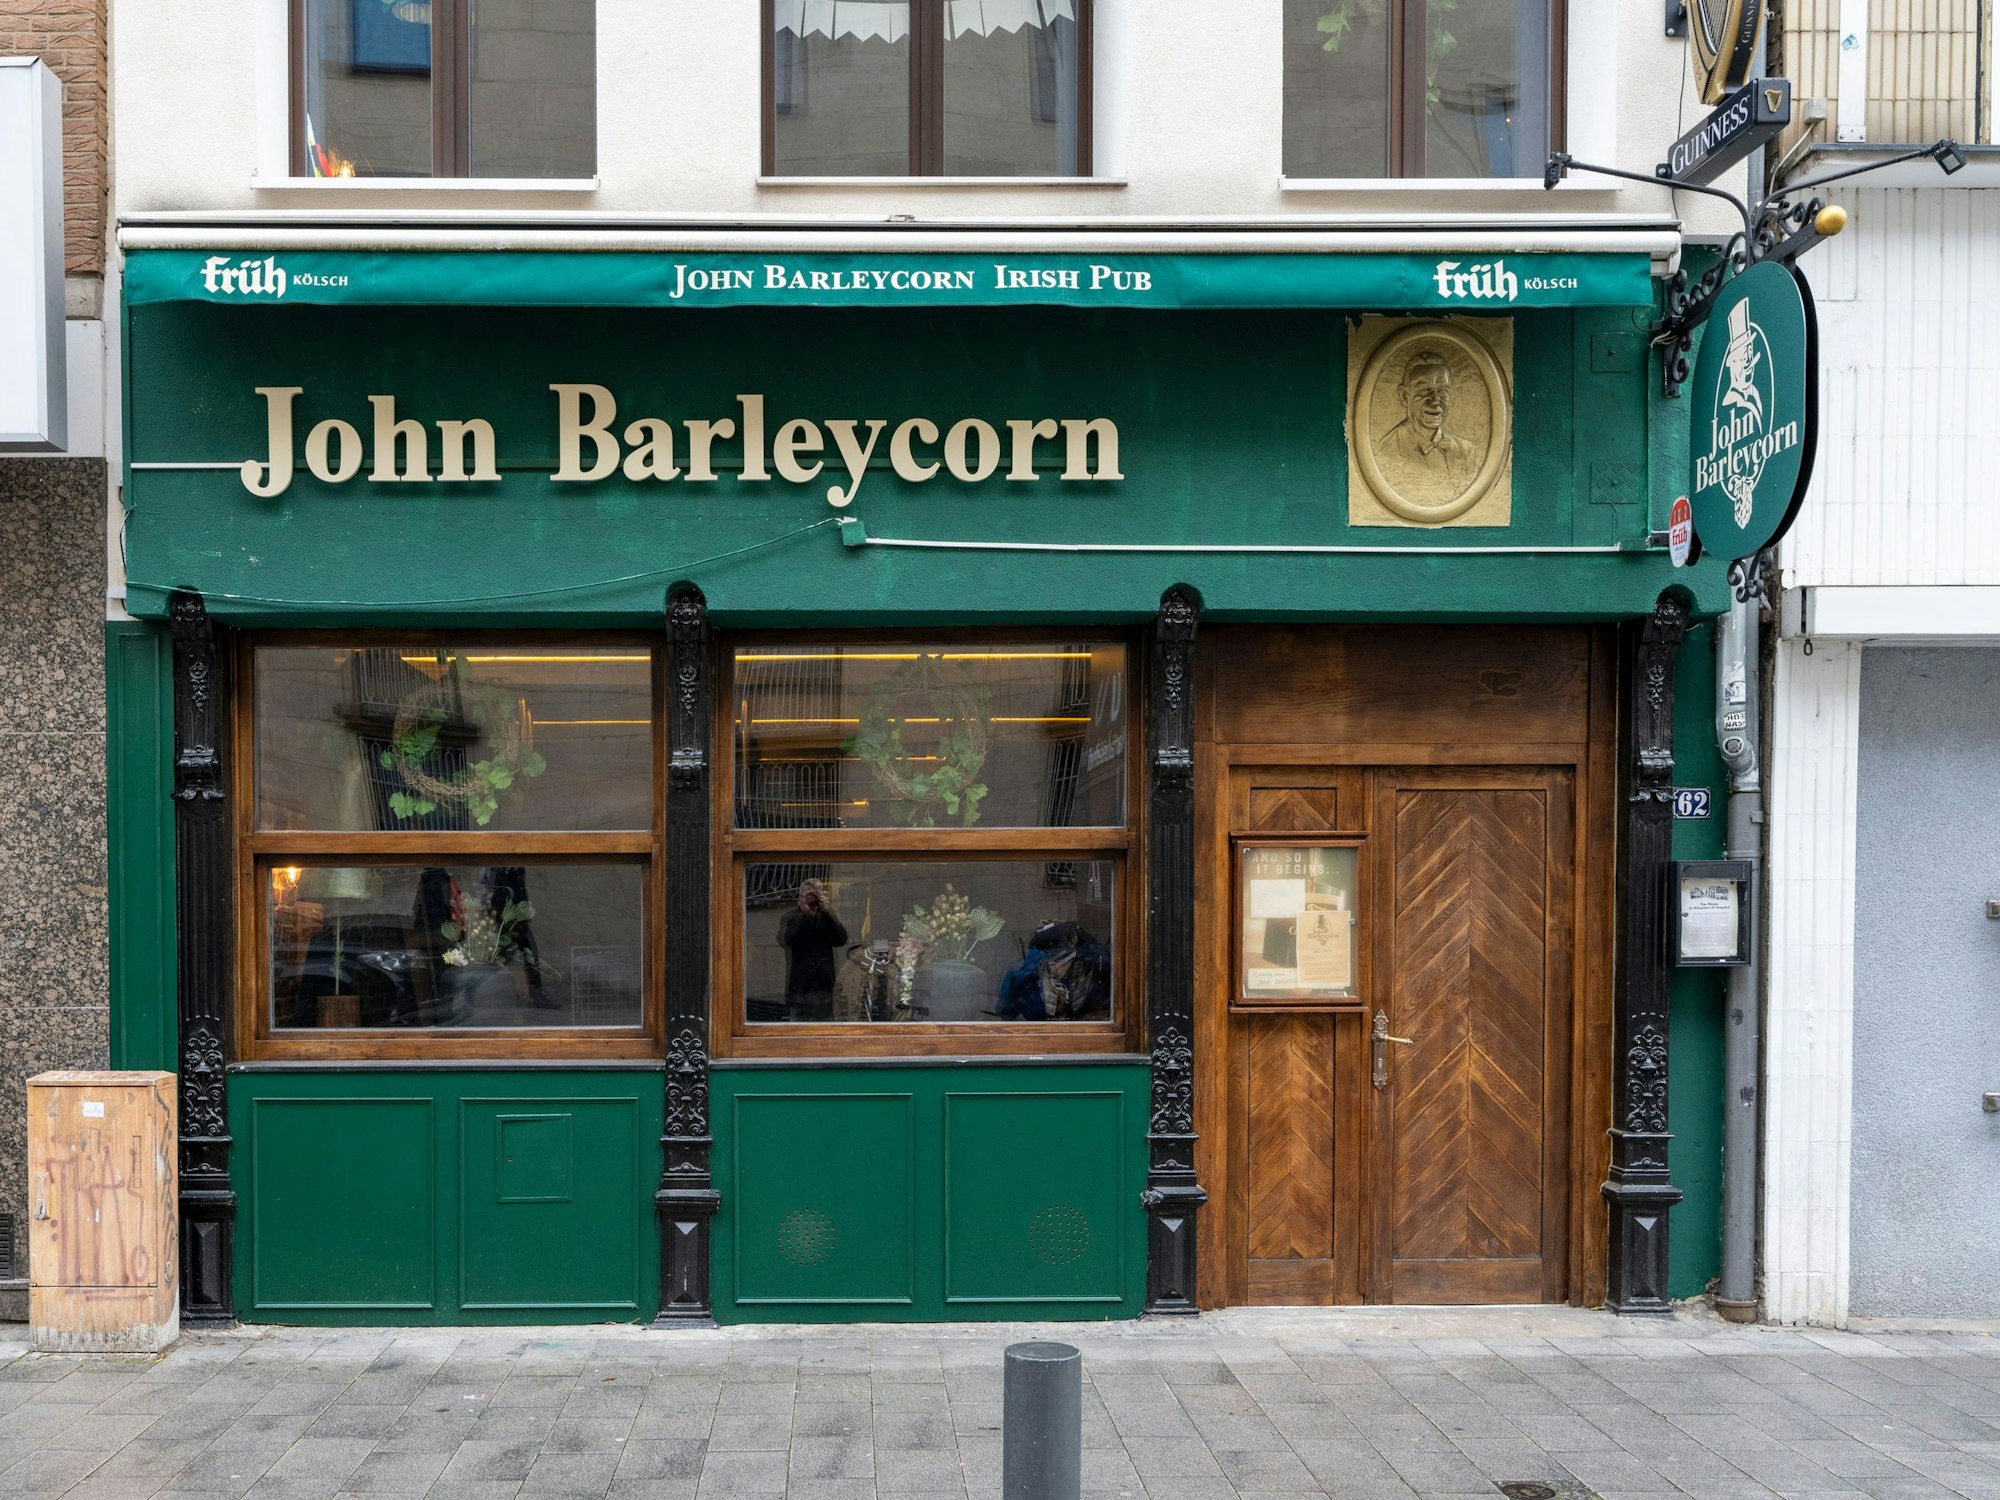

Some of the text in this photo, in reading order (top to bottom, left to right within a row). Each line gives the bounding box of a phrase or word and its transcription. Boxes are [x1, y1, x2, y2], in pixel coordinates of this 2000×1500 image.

[1671, 96, 1749, 174] GUINNESS
[200, 256, 348, 299] früh KÖLSCH
[670, 265, 1152, 298] JOHN BARLEYCORN IRISH PUB
[1433, 259, 1577, 302] früh KÖLSCH
[240, 384, 1125, 507] John Barleycorn
[1709, 408, 1755, 461] John
[1695, 420, 1798, 494] Barleycorn
[1678, 792, 1707, 816] 62
[1252, 852, 1302, 863] AND SO
[1257, 864, 1270, 874] IT
